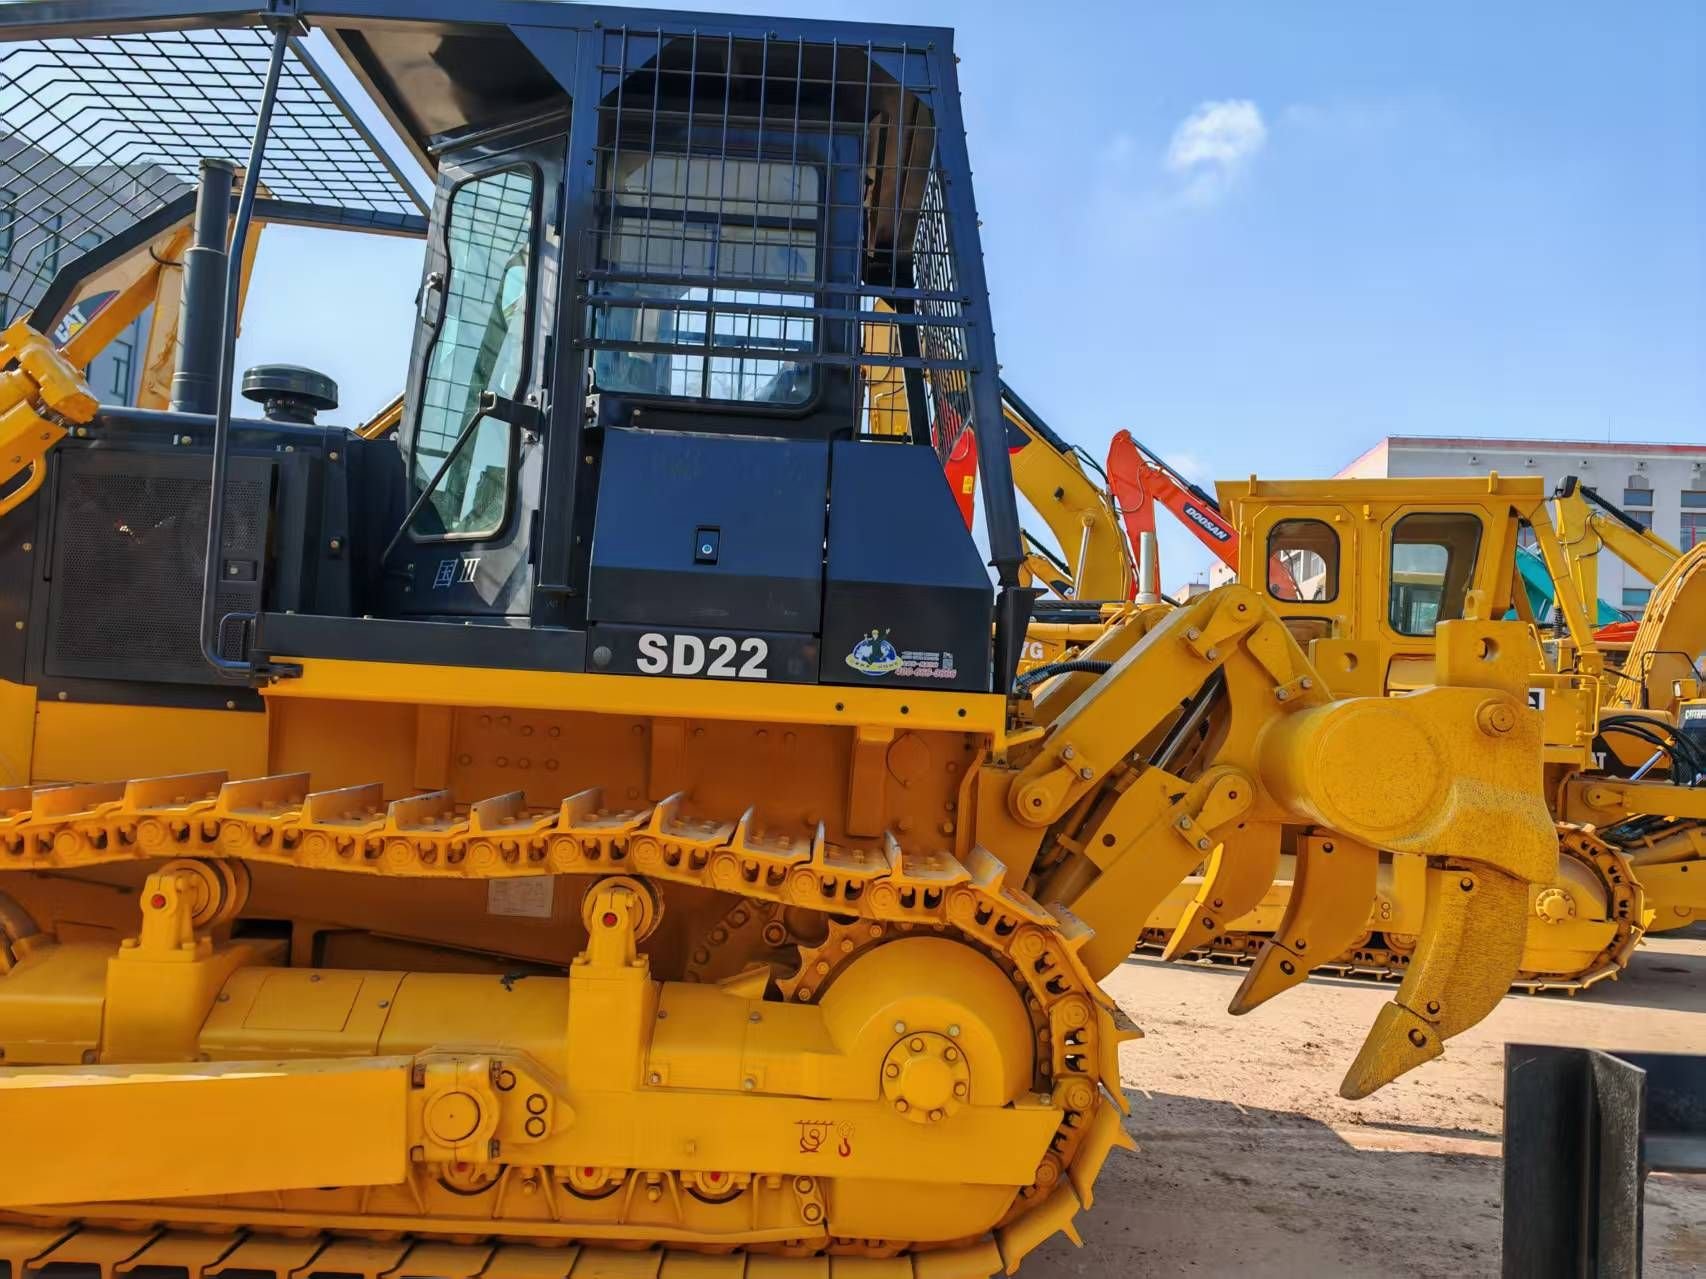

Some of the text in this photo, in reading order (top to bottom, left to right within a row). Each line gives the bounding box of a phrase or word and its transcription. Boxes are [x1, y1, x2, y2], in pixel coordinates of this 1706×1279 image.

[54, 304, 88, 343] CAT
[1185, 507, 1228, 539] DOOSAN
[636, 633, 768, 678] SD22
